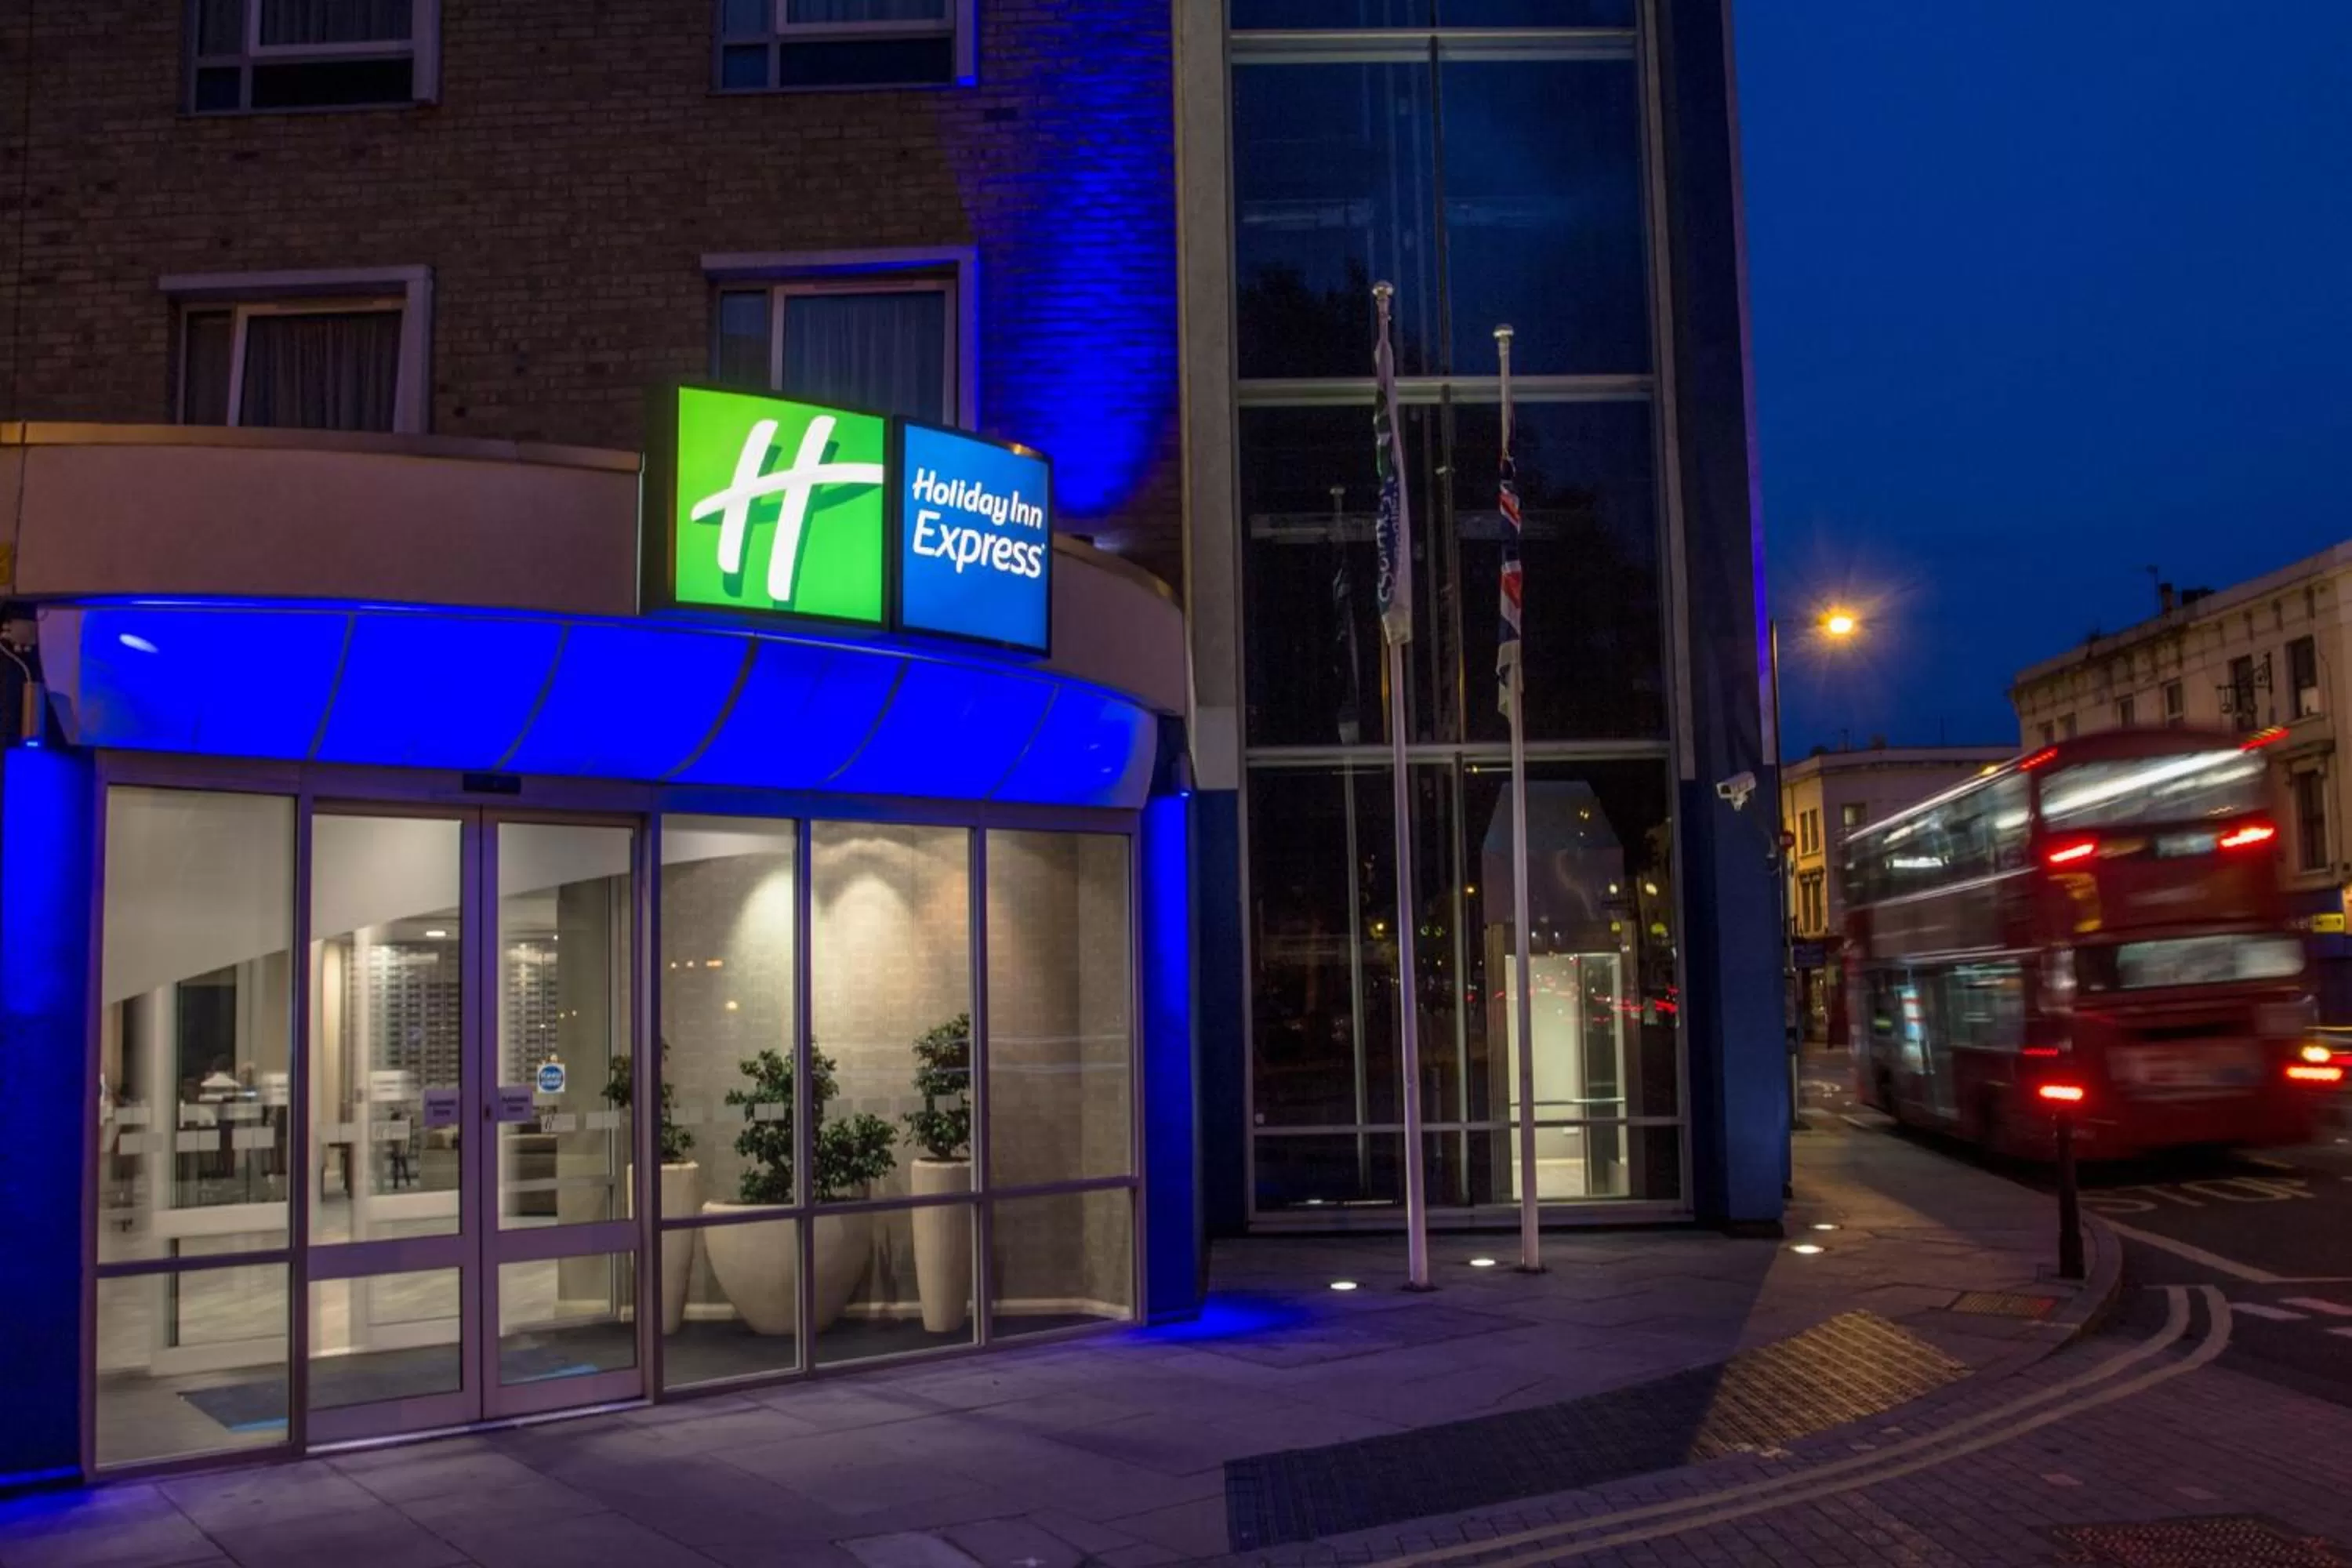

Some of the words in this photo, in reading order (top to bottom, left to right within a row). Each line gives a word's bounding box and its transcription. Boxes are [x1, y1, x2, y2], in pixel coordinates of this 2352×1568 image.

[912, 467, 1009, 526] Holiday
[1009, 490, 1044, 531] Inn
[912, 509, 1043, 579] Express
